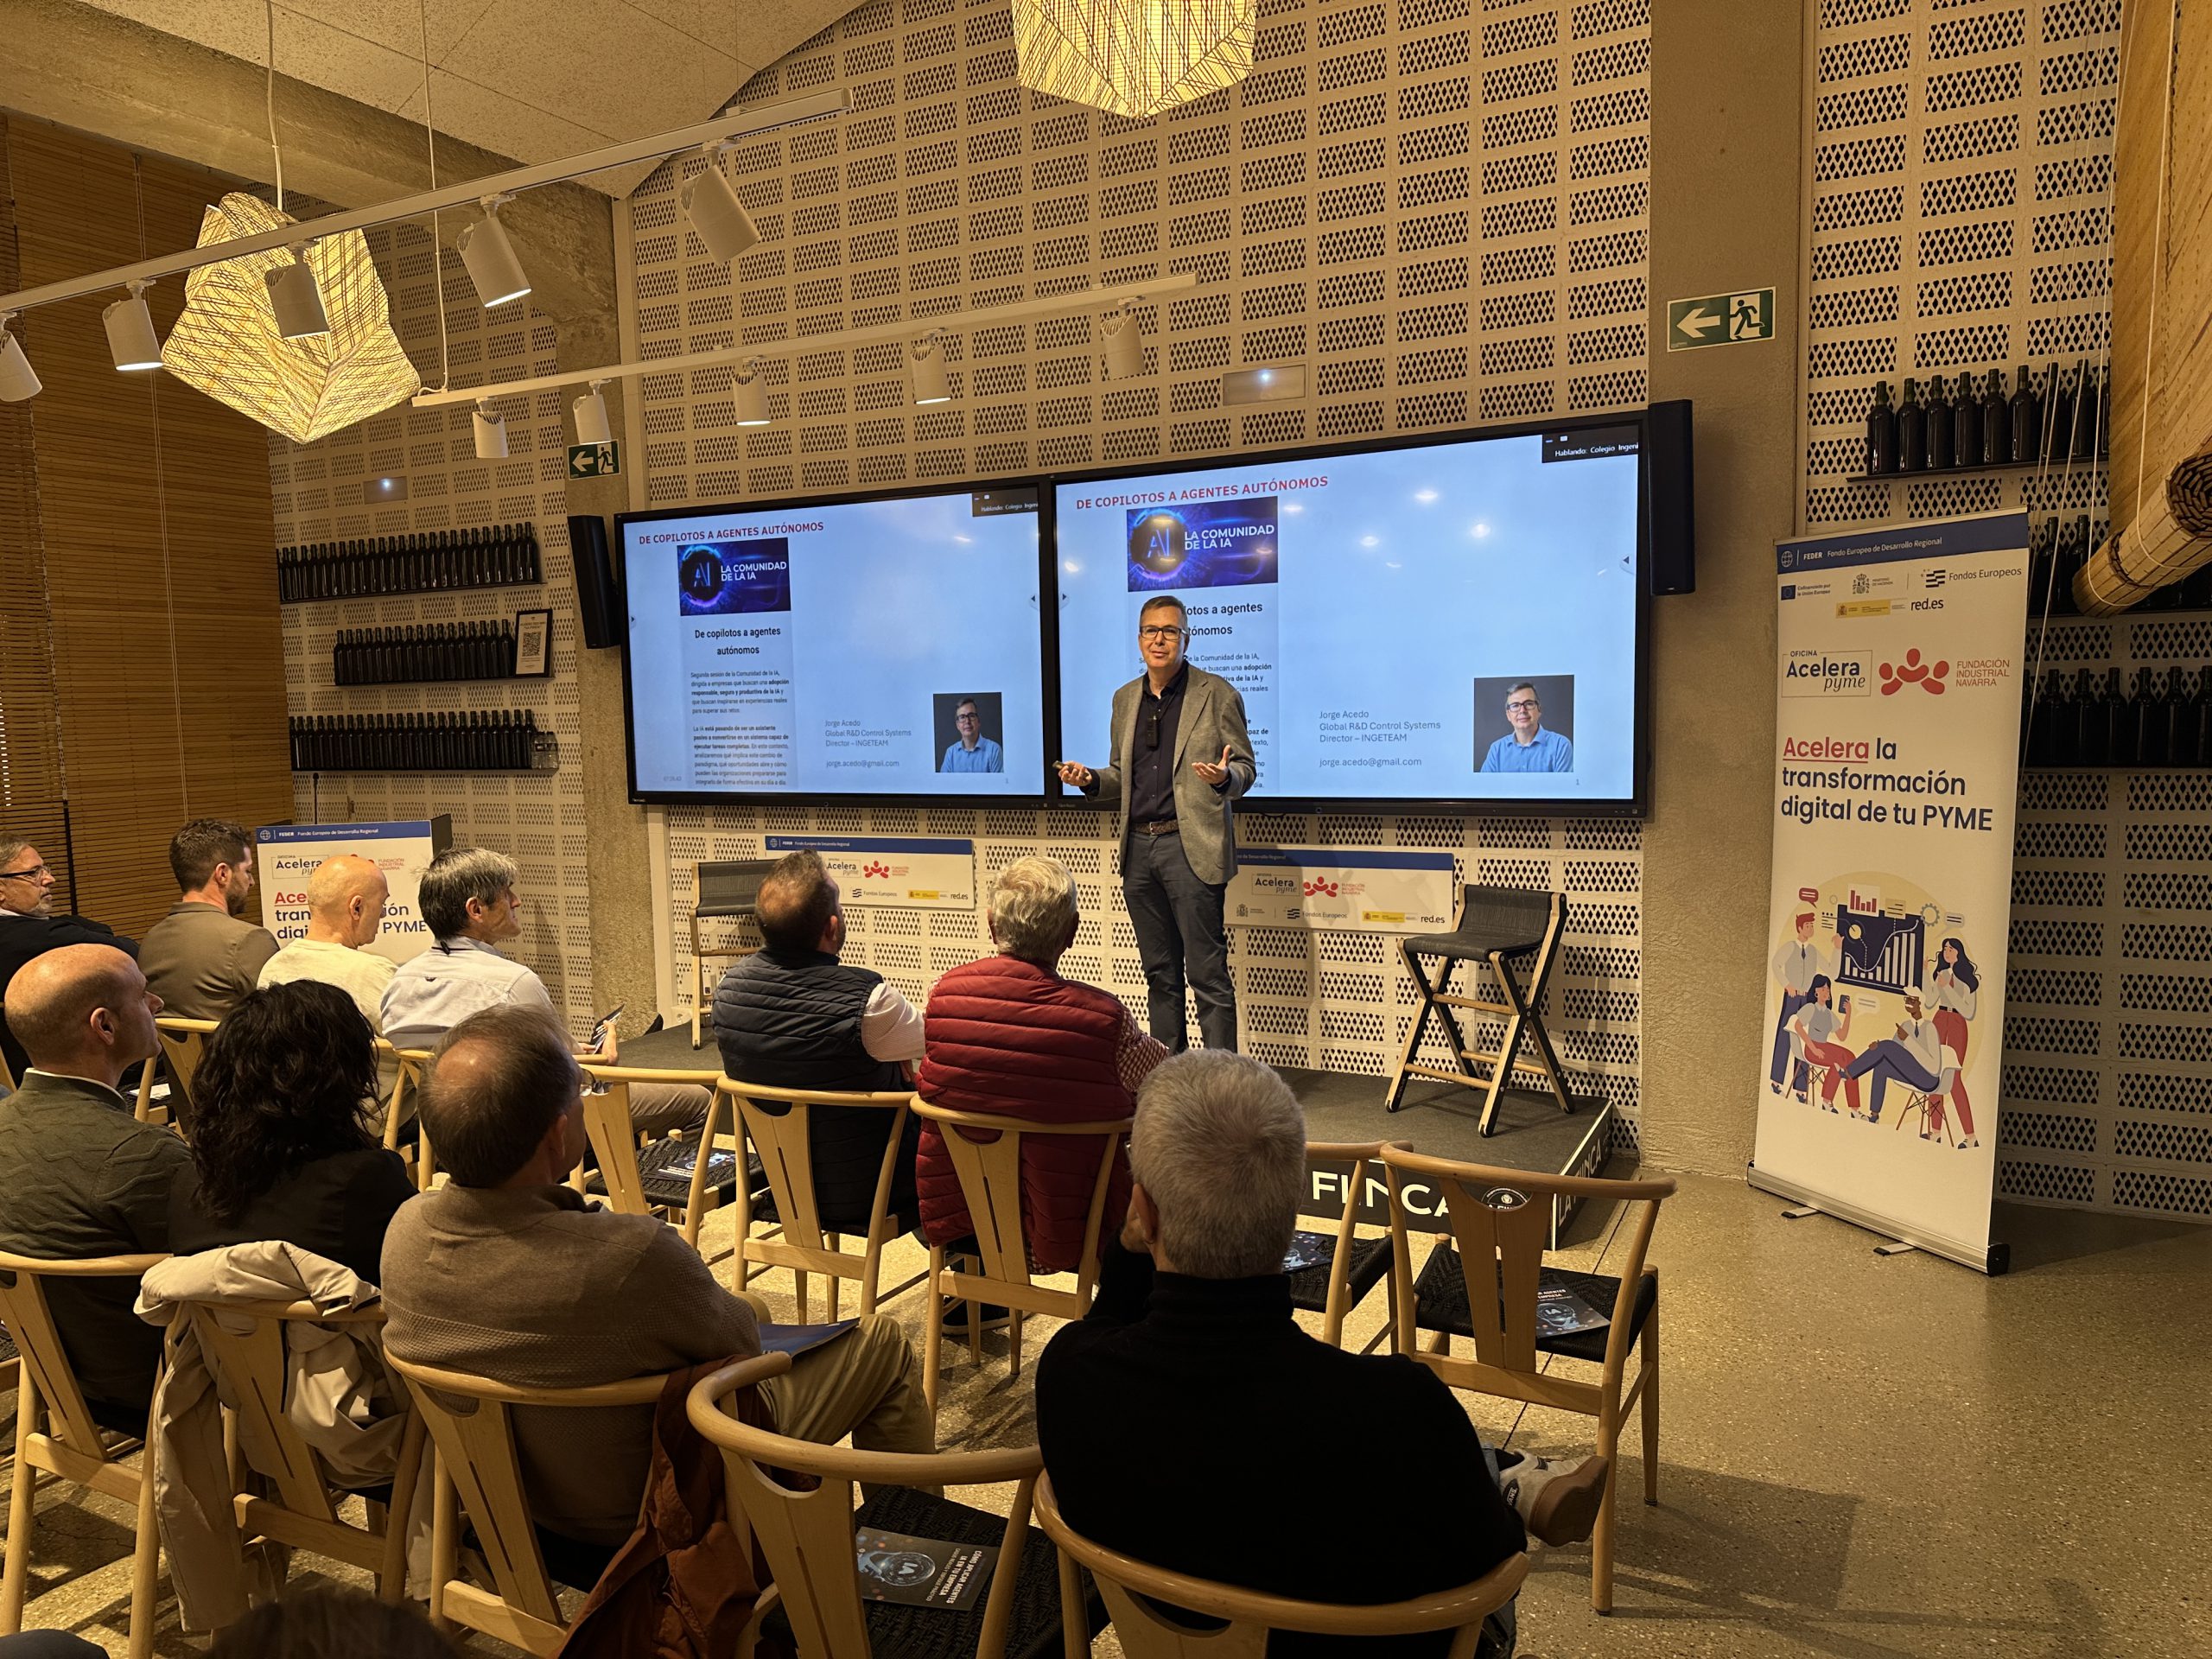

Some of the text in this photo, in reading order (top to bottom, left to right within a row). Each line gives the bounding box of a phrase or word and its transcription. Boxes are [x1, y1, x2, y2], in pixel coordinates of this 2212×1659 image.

[1077, 476, 1328, 510] DE COPILOTOS A AGENTES AUTÓNOMOS
[639, 536, 651, 544] DE
[653, 531, 705, 543] COPILOTOS
[716, 527, 759, 539] AGENTES
[761, 521, 824, 535] AUTÓNOMOS
[1185, 524, 1274, 541] LA COMUNIDAD
[1185, 538, 1232, 550] DE LA IA
[1803, 551, 1822, 560] FEDER
[1847, 547, 1872, 556] Europeo
[1881, 542, 1913, 551] Desarrollo
[1914, 537, 1942, 547] Regional
[733, 562, 787, 573] COMUNIDAD
[721, 573, 733, 582] DE
[734, 572, 746, 581] LA
[1948, 568, 2022, 581] Fondos Europeos
[1220, 602, 1262, 616] agentes
[1910, 598, 1944, 611] red.es
[695, 629, 705, 639] De
[706, 628, 741, 639] copilotos
[749, 627, 781, 638] agentes
[1188, 626, 1233, 636] tónomos
[716, 645, 760, 655] autónomos
[1243, 663, 1272, 671] adopción
[1786, 657, 1859, 678] Acelera
[1956, 658, 2010, 669] FUNDACIÓN
[1956, 668, 2010, 677] INDUSTRIAL
[1823, 677, 1866, 692] pyme
[1955, 677, 1997, 687] NAVARRA
[1319, 710, 1340, 720] Jorge
[824, 720, 841, 728] Jorge
[1319, 722, 1348, 731] Global
[1370, 721, 1402, 730] Control
[1403, 721, 1440, 731] Systems
[885, 729, 912, 738] Systems
[1361, 734, 1407, 742] INGETEAM
[1783, 736, 1897, 760] Acelera la
[1319, 758, 1421, 767] jorge.acedo@gmail.com
[1783, 766, 1966, 796] transformación
[1781, 794, 1993, 831] digital de tu PYME
[826, 861, 857, 870] Acelera
[1255, 877, 1294, 887] Acelera
[1421, 915, 1445, 924] red.es
[277, 920, 427, 939] digi PYME
[938, 1573, 957, 1596] EMPRESA
[945, 1582, 963, 1604] AGENTES
